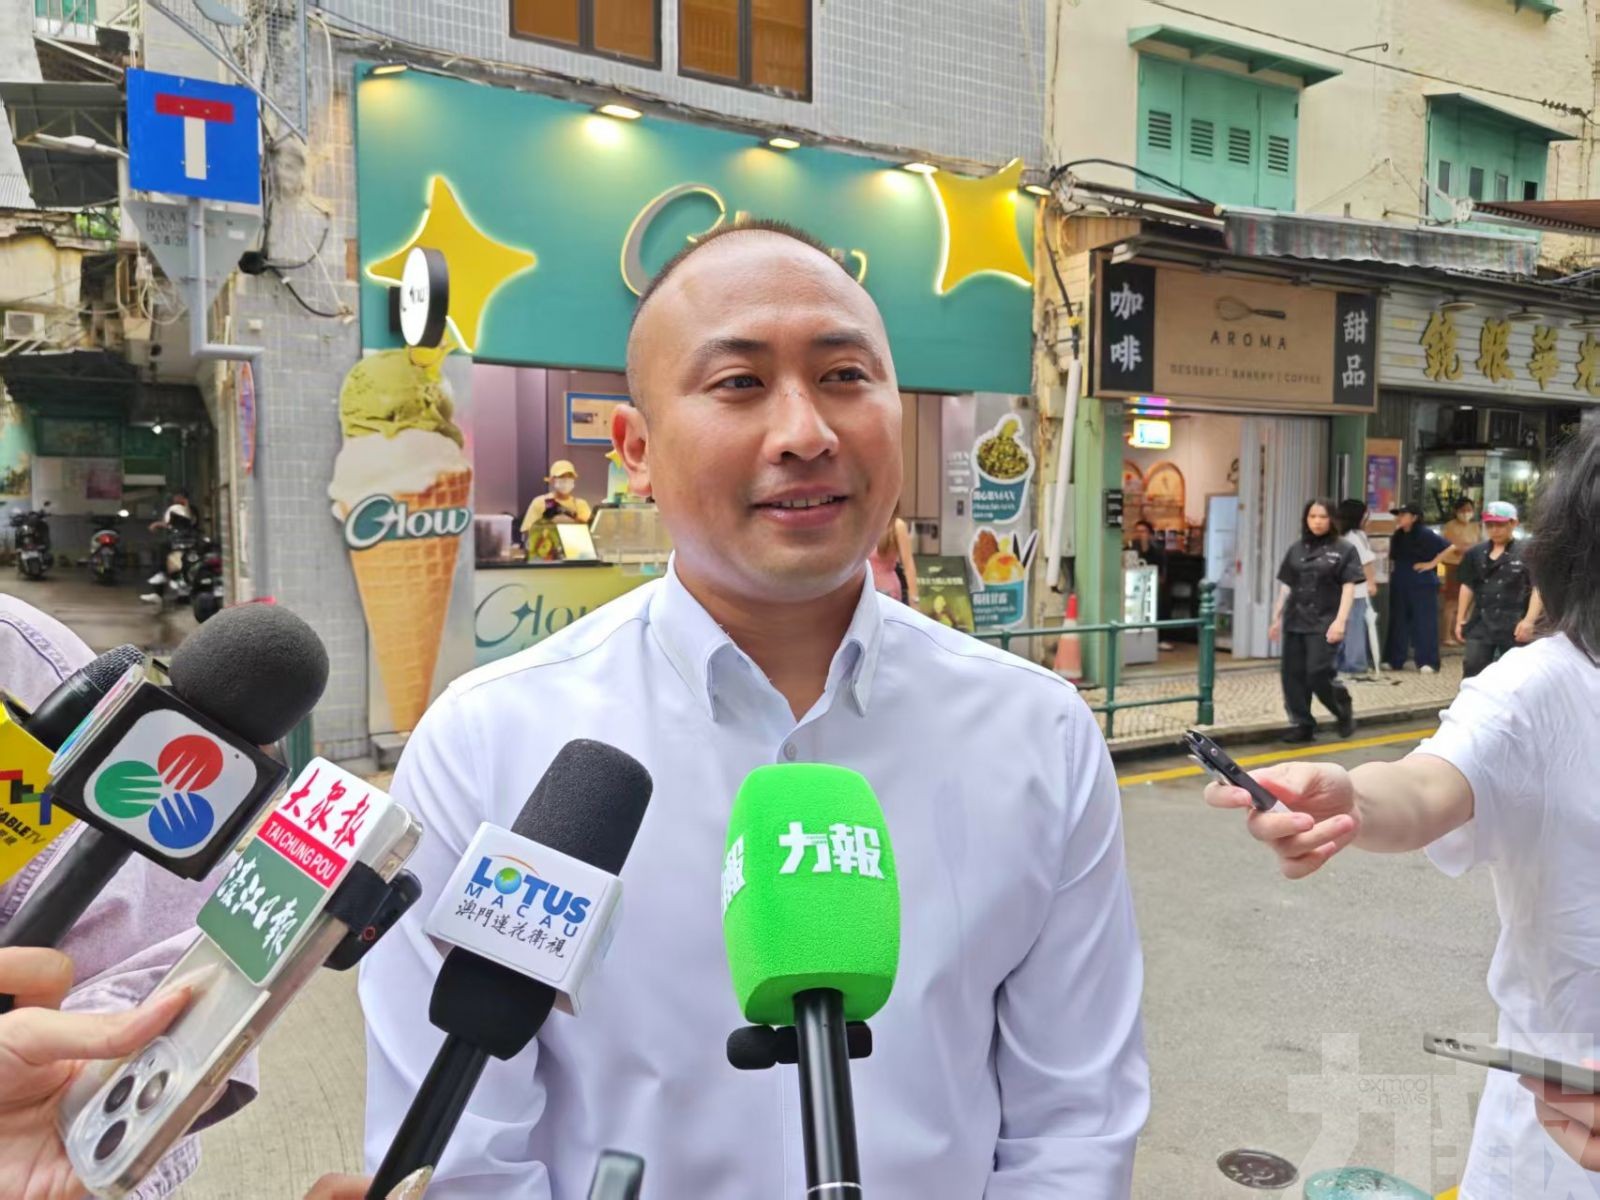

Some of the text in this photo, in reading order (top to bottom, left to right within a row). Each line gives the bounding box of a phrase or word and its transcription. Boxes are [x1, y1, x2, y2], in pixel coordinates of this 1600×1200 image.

[1109, 281, 1145, 373] 咖啡
[1210, 331, 1288, 351] AROMA
[1341, 309, 1369, 389] 甜品
[347, 495, 470, 549] Glow
[474, 583, 602, 648] Glo
[265, 820, 338, 880] TAI CHUNG POU
[778, 821, 886, 880] 力報
[464, 882, 578, 938] MACAU
[471, 856, 592, 924] LOTUS
